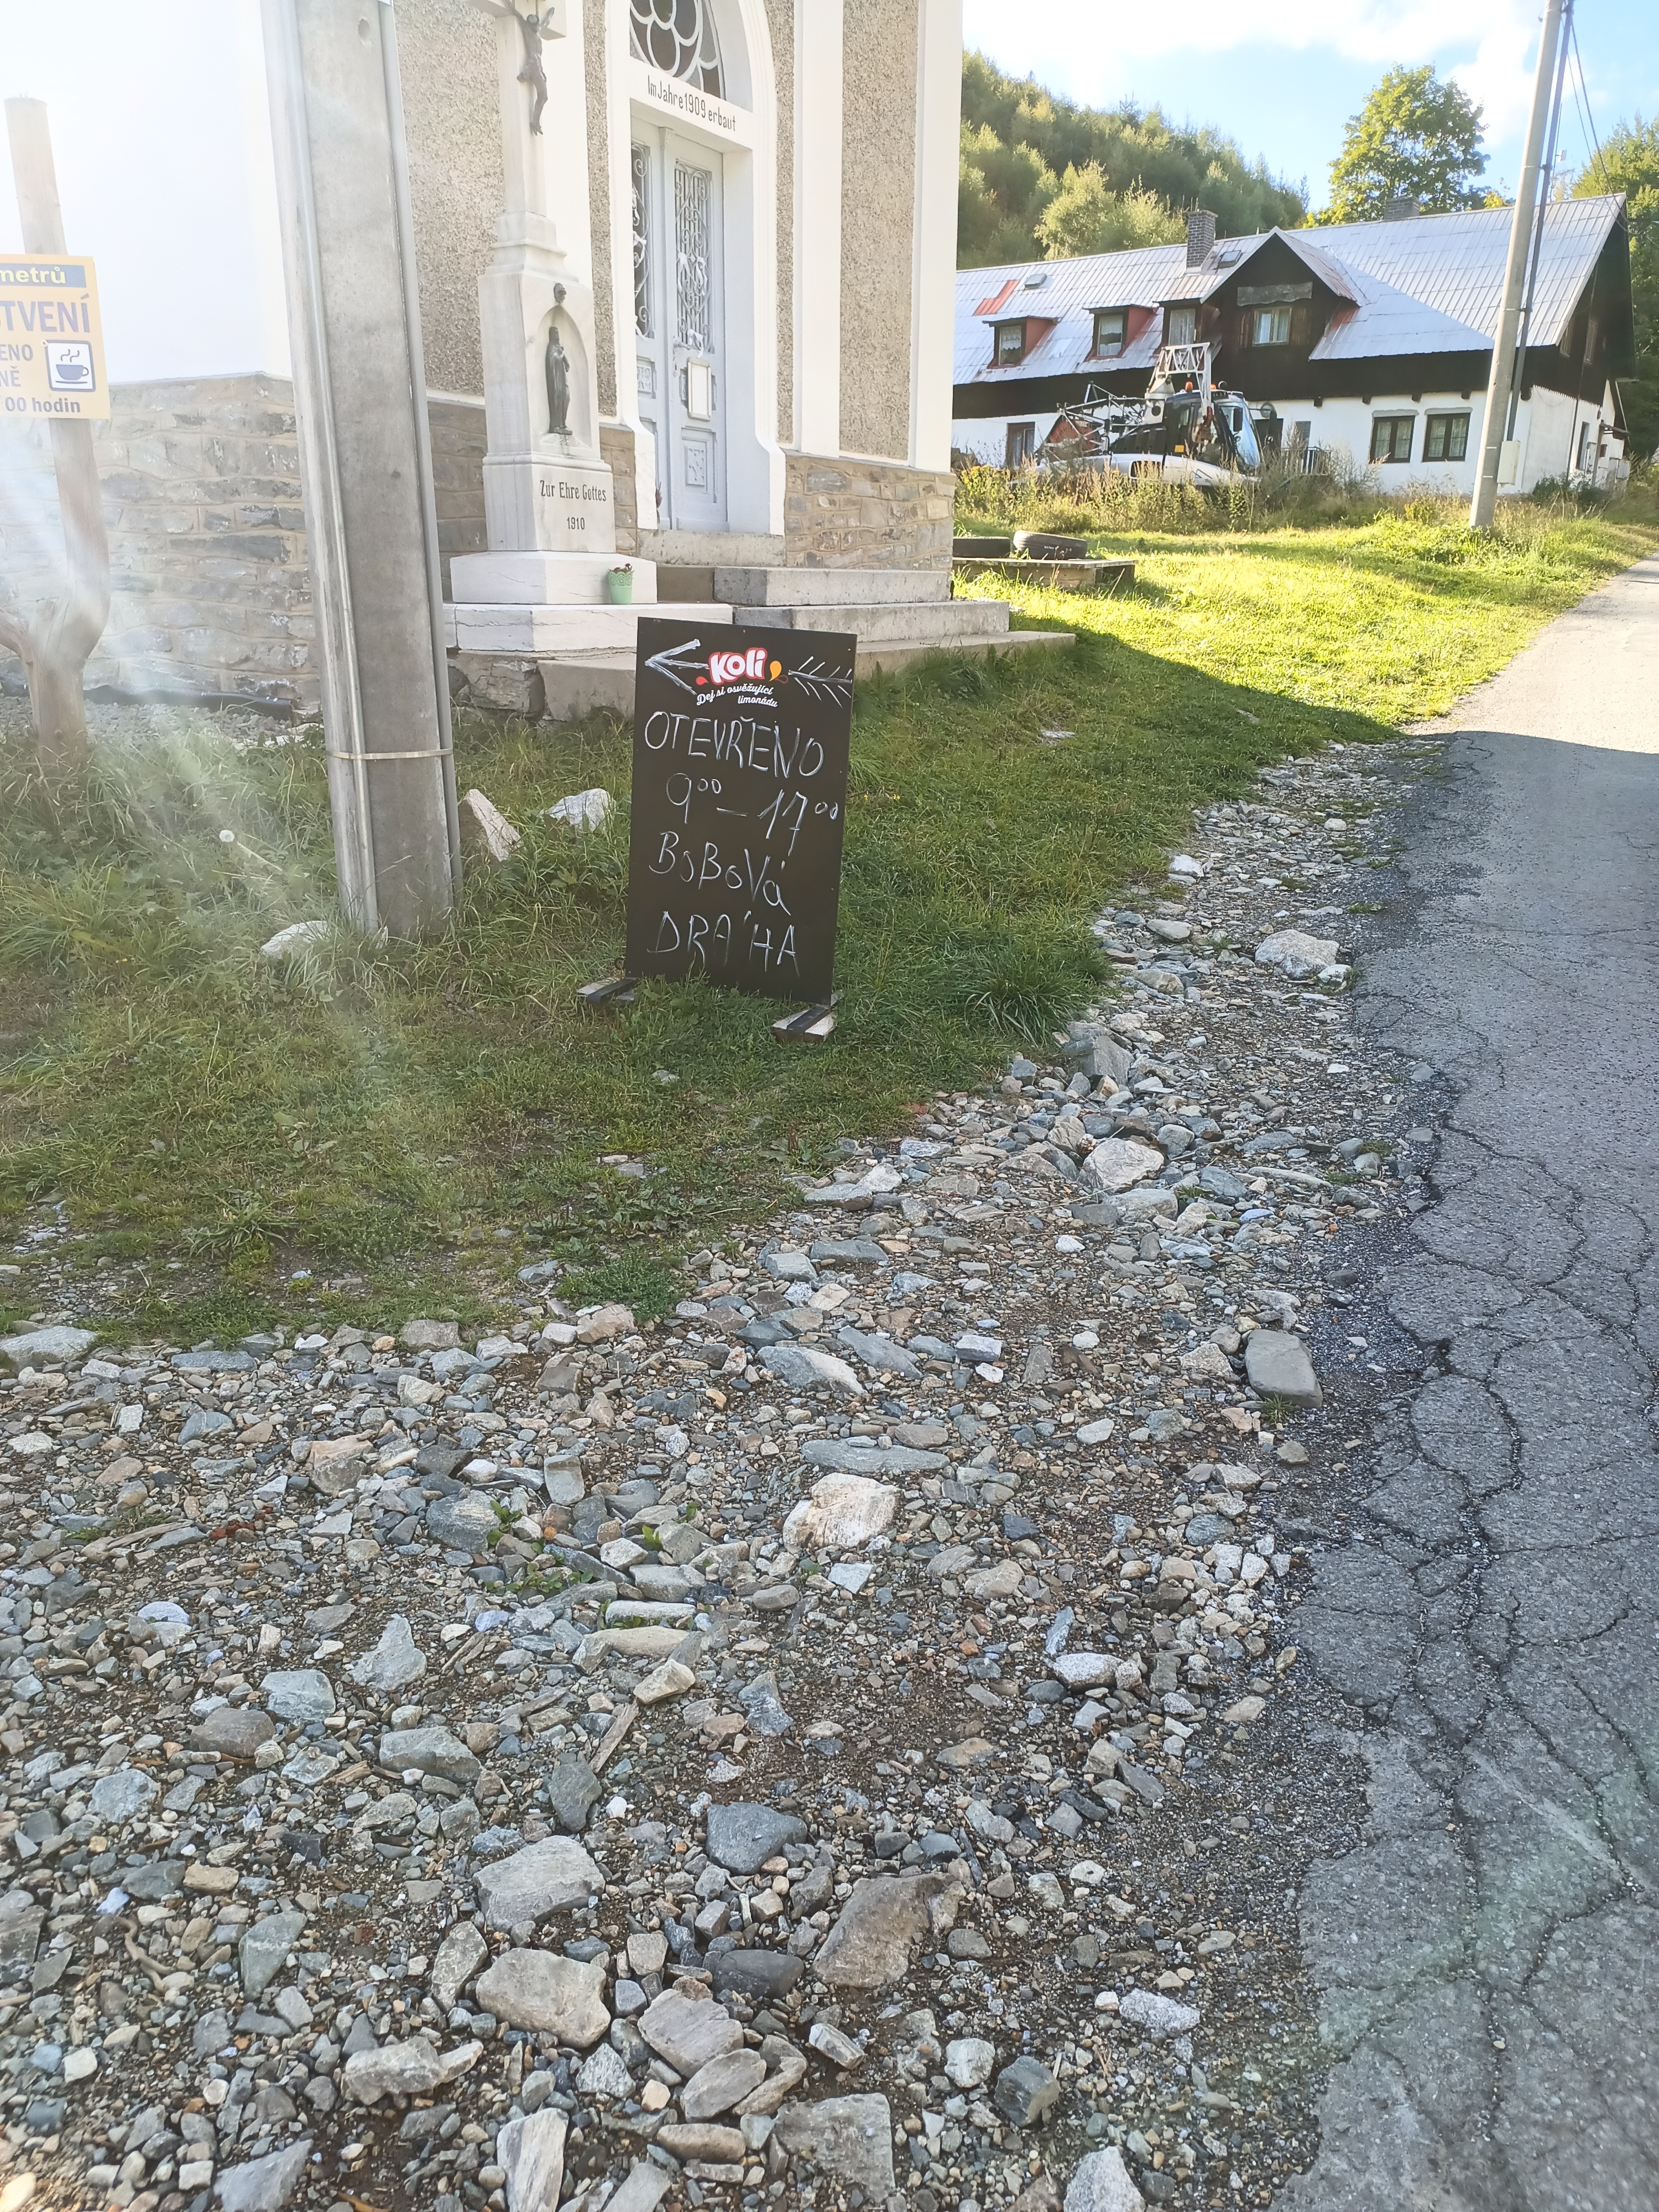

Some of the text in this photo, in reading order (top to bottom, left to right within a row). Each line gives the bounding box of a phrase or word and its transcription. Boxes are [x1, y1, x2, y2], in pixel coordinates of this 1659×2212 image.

[648, 75, 736, 131] Im Jahre 1909 erbaut
[0, 293, 90, 333] TVENÍ
[32, 398, 81, 413] hodin
[540, 480, 607, 502] Zur Ehre Gottes
[567, 517, 585, 530] 1910
[696, 683, 774, 706] Dej si osvěžující
[738, 695, 779, 708] limonádu
[644, 711, 824, 779] OTEVŘENO
